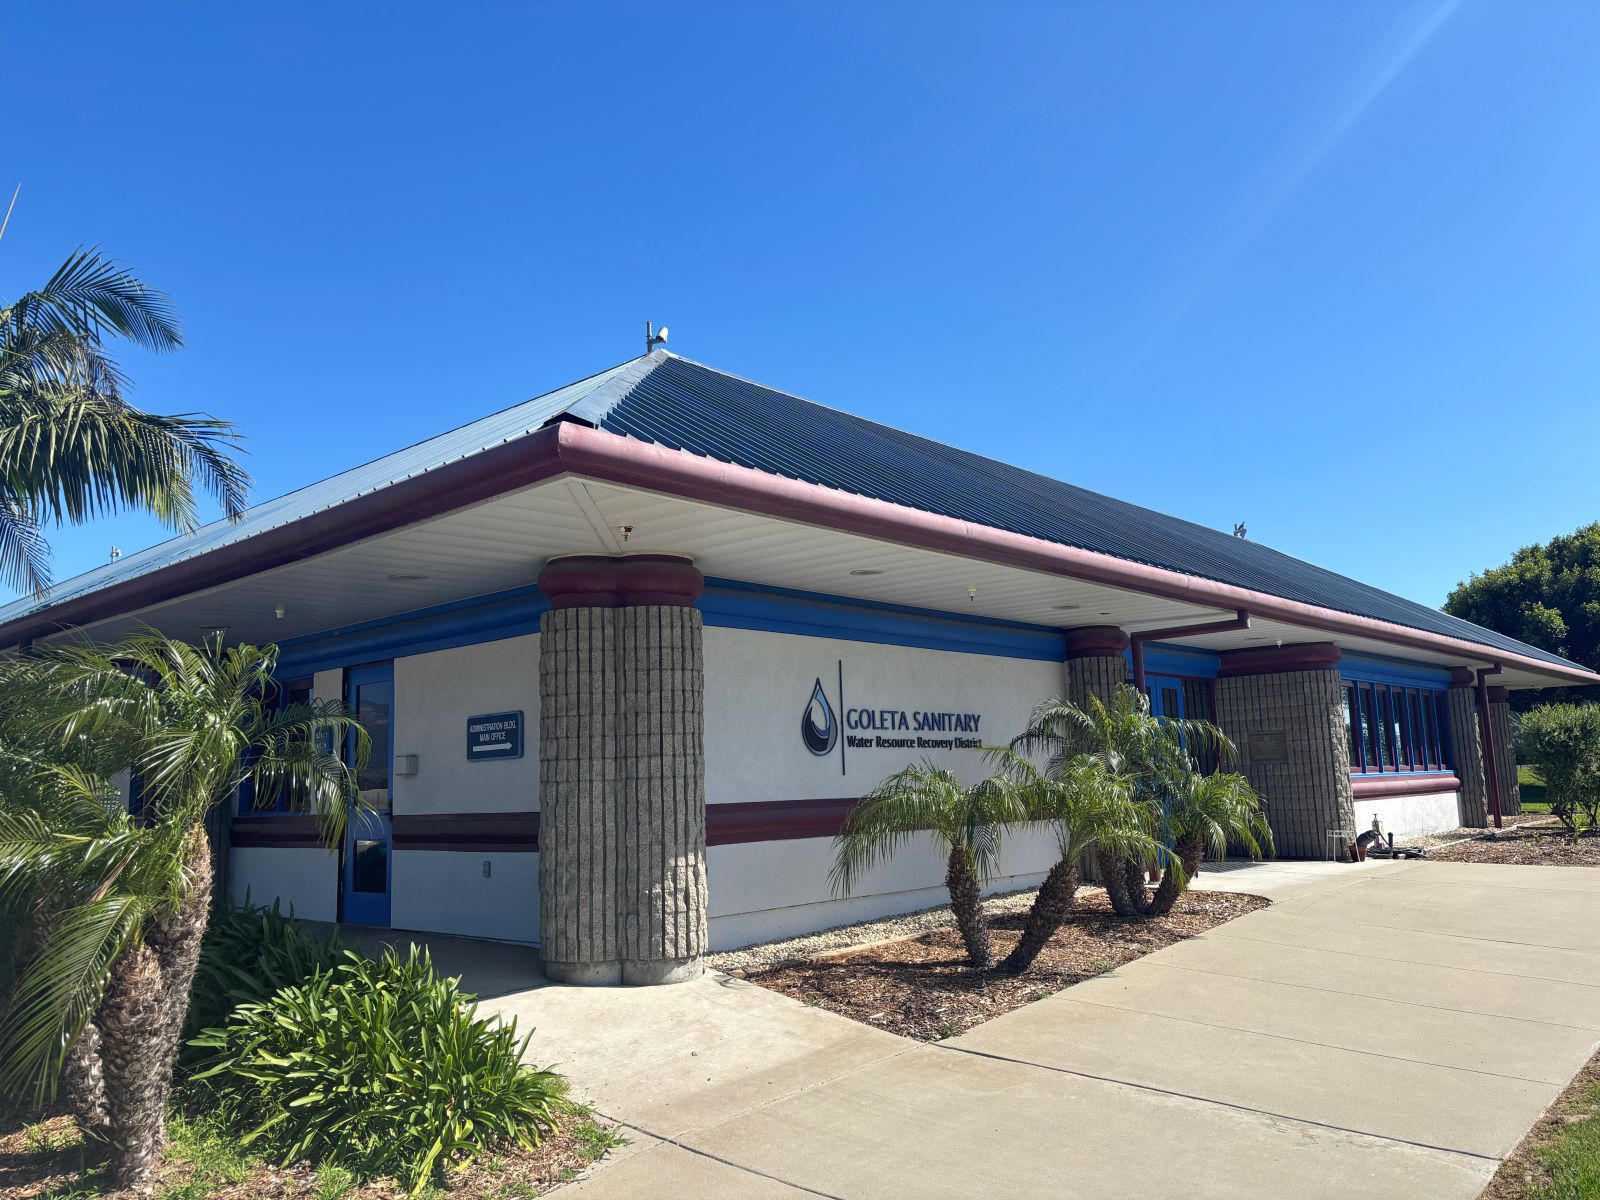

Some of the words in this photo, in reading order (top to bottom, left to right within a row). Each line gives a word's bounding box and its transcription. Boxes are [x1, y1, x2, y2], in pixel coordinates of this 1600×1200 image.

[503, 720, 516, 730] BLDG
[846, 708, 909, 731] GOLETA
[913, 711, 981, 732] SANITARY
[480, 733, 490, 742] MAIN
[490, 732, 506, 740] OFFICE
[846, 735, 874, 748] Water
[876, 735, 916, 748] Resource
[917, 736, 953, 750] Recovery
[954, 738, 982, 748] District
